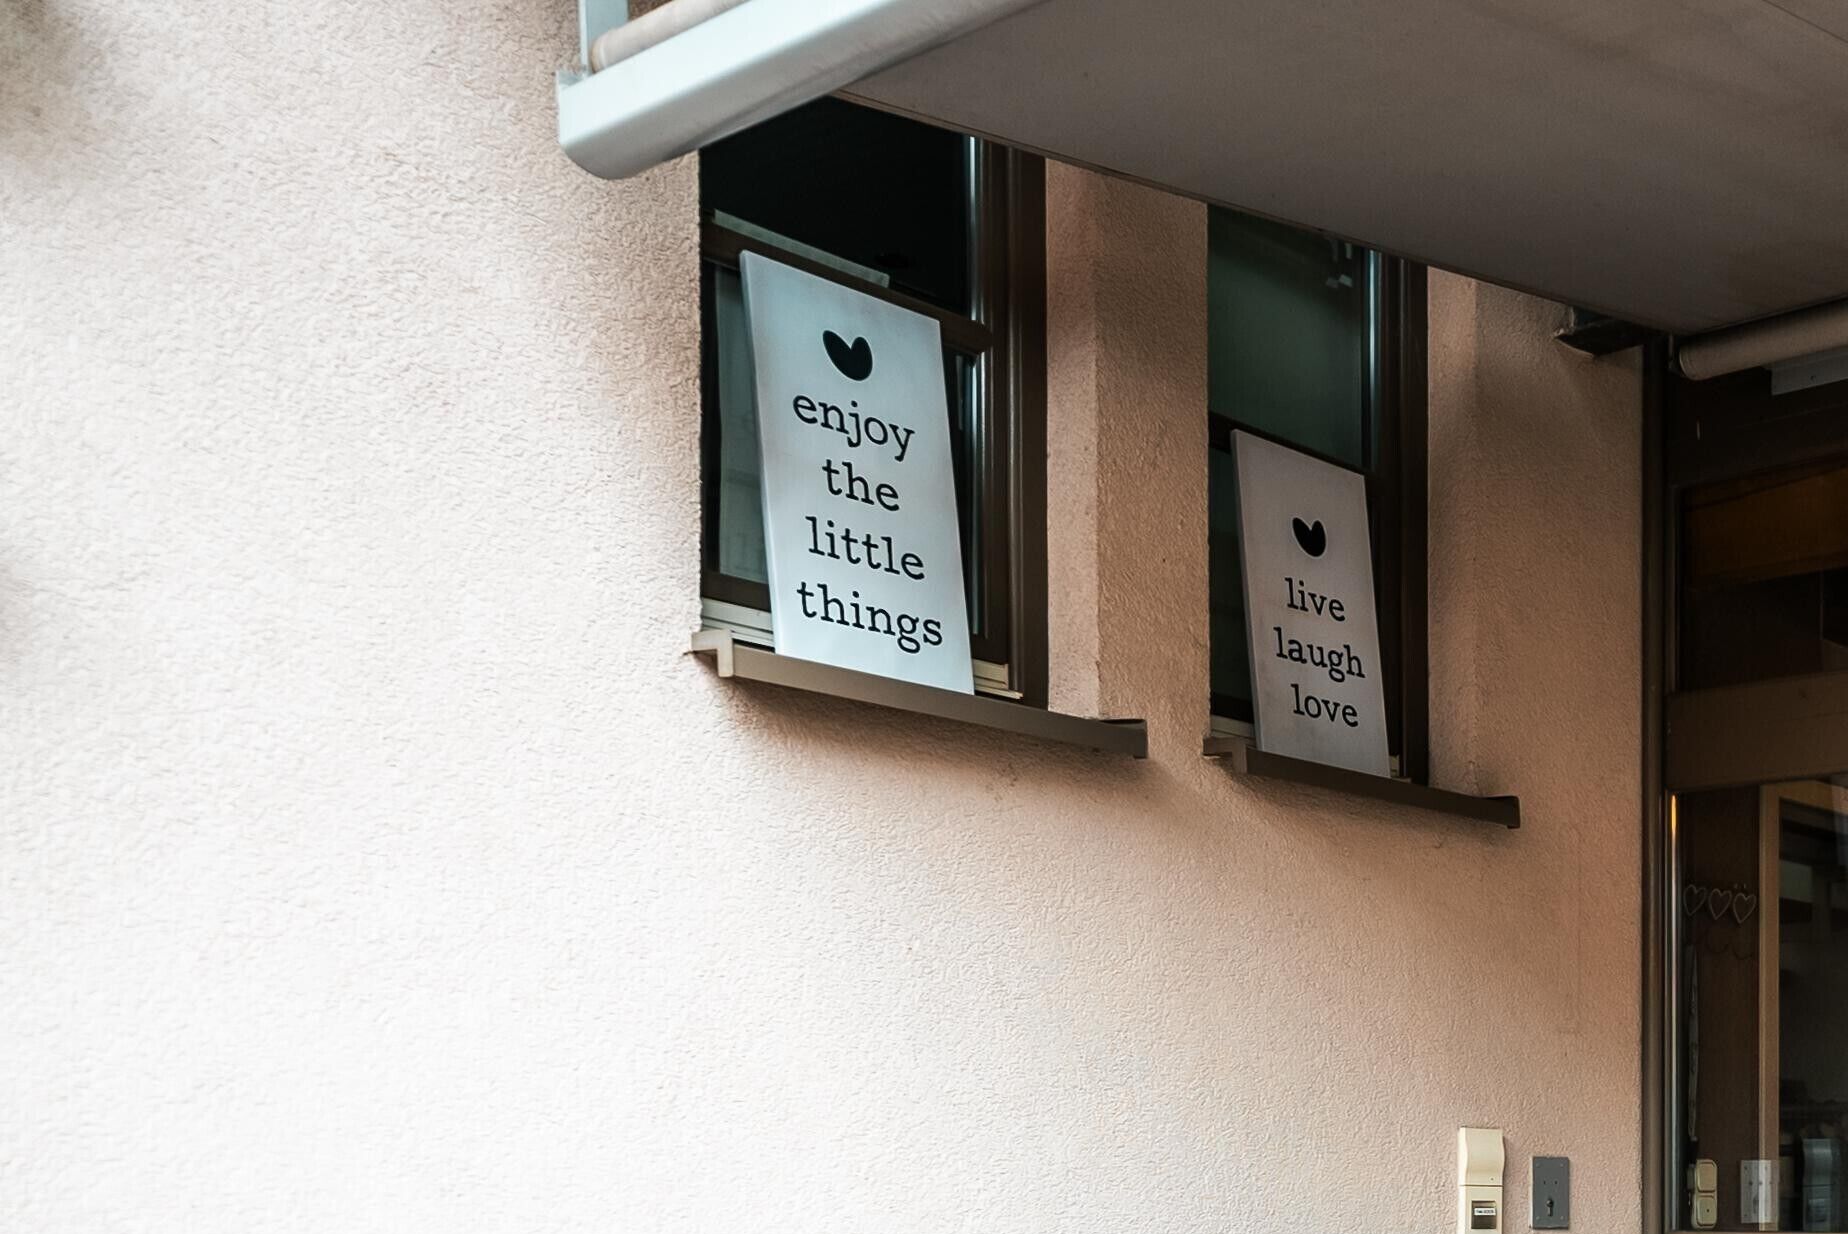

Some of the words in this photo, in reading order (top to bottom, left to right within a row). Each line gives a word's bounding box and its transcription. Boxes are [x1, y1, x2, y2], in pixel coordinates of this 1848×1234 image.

[792, 395, 916, 463] enjoy
[821, 459, 900, 512] the
[805, 516, 925, 581] little
[796, 581, 943, 654] things
[1284, 577, 1346, 622] live
[1273, 626, 1366, 683] laugh
[1290, 683, 1359, 728] love
